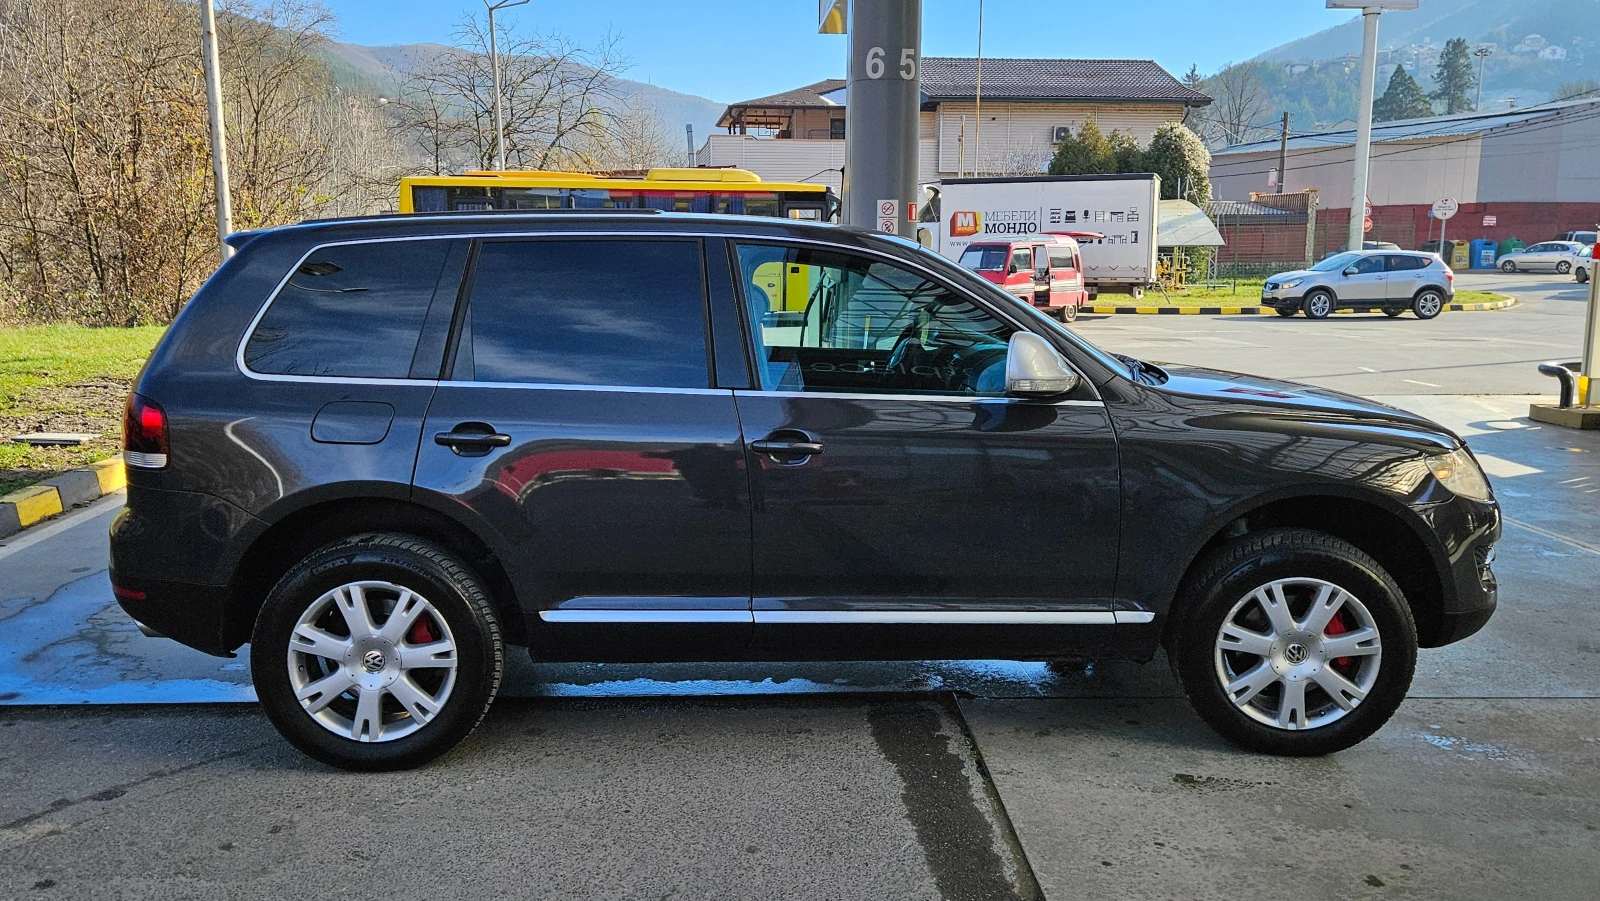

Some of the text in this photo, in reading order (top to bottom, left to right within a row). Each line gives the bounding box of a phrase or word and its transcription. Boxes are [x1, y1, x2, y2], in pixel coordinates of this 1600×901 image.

[866, 47, 915, 80] 6 5
[985, 211, 1036, 221] МЕБЕЛИ
[985, 222, 1037, 234] МОНДО
